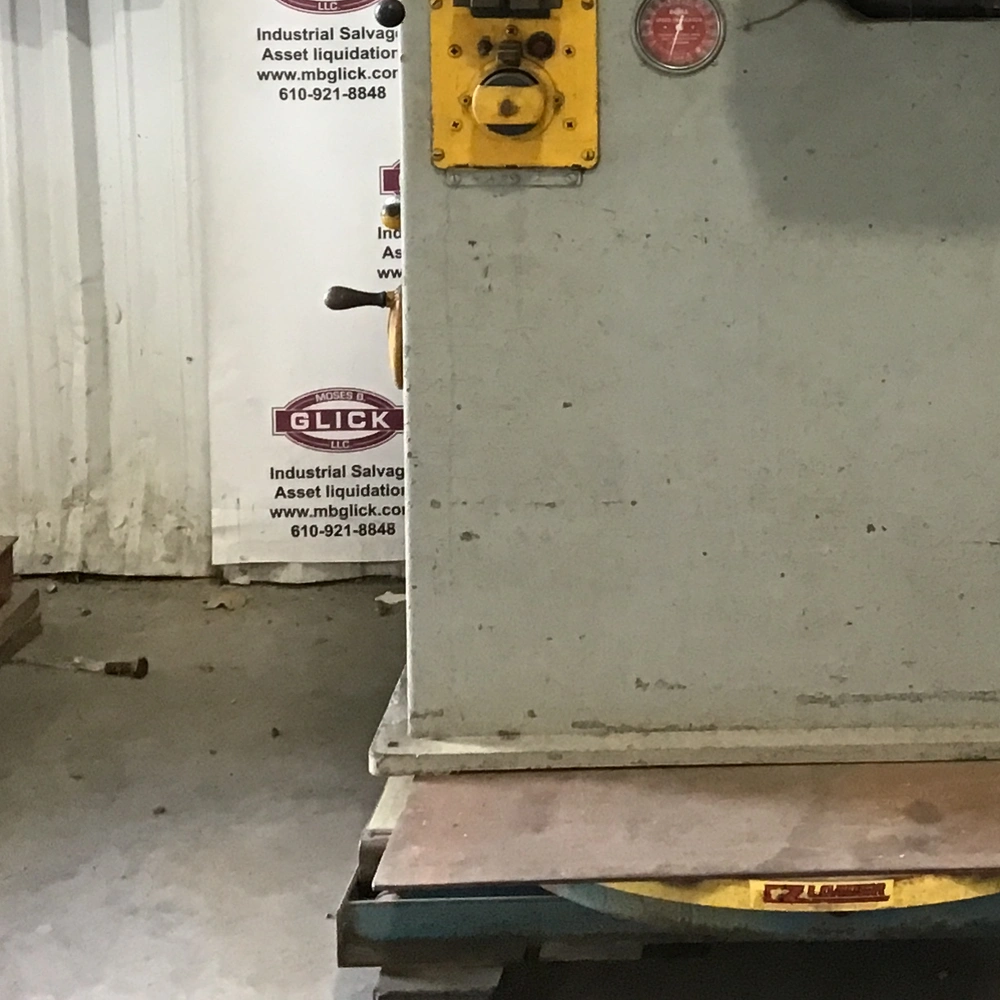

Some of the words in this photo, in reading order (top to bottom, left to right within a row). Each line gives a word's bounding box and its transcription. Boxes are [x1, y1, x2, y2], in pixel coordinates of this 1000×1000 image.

[257, 27, 334, 41] Industrial
[340, 27, 398, 42] Salvag
[262, 48, 308, 61] Asset
[279, 86, 387, 101] 610-921-8848
[315, 392, 353, 402] MOSES
[291, 411, 390, 430] GLICK
[270, 465, 346, 480] Industrial
[351, 465, 405, 480] Salvag
[275, 486, 321, 499] Asset
[270, 504, 405, 520] www.mbglick.co
[291, 523, 396, 537] 610-921-8848
